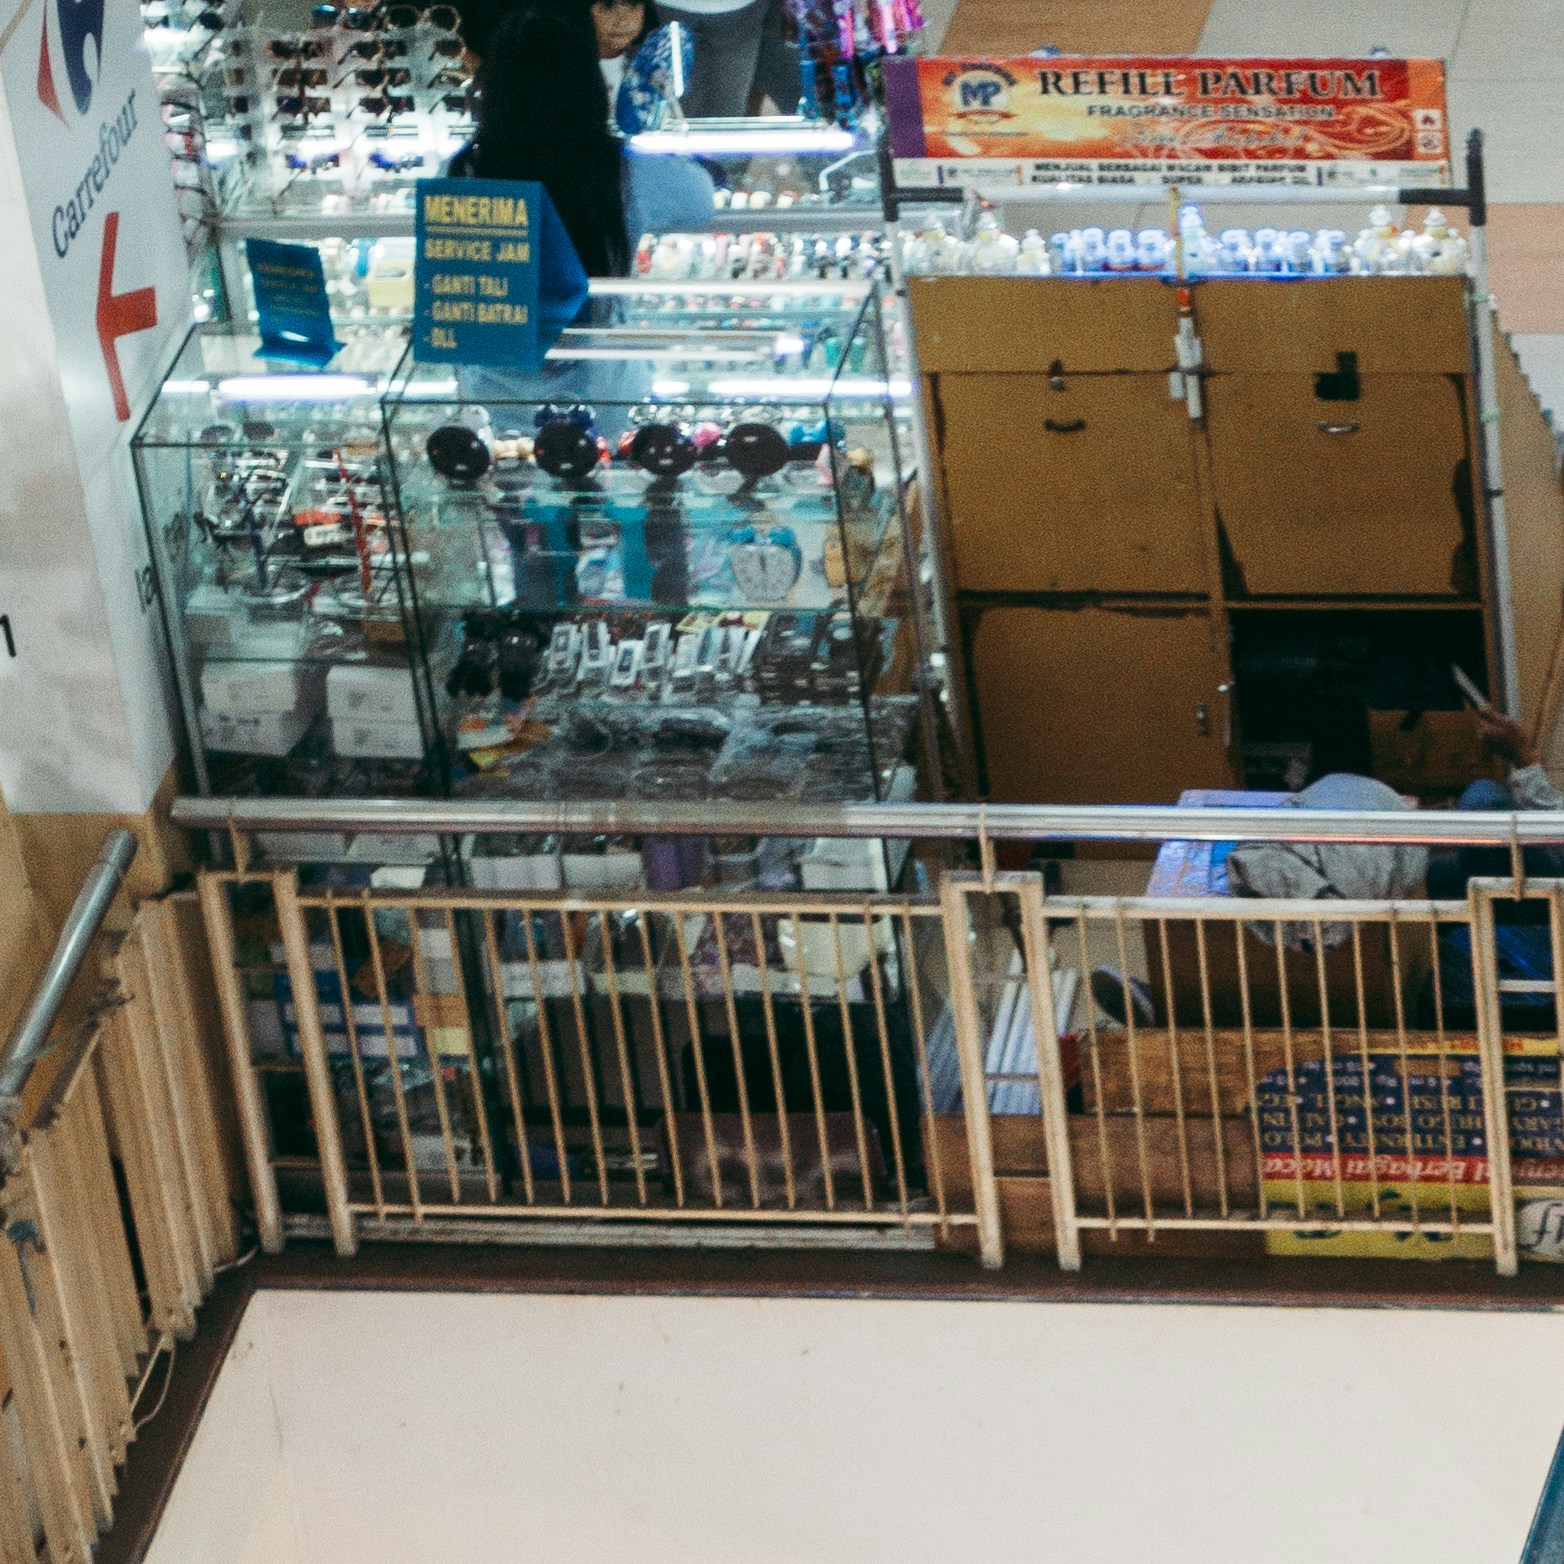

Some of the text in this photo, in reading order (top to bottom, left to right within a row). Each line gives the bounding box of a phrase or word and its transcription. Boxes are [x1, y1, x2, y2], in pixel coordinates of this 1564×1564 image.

[1039, 70, 1185, 97] REFILL
[1198, 70, 1382, 98] PARFUM
[1087, 104, 1334, 118] FRAGRANCE SENSATION
[52, 88, 138, 259] Carrefour
[424, 194, 529, 226] MENERIMA
[424, 238, 531, 263] SERVICE JAM
[431, 273, 509, 298] GANTI TALI
[431, 301, 475, 322] GANTI
